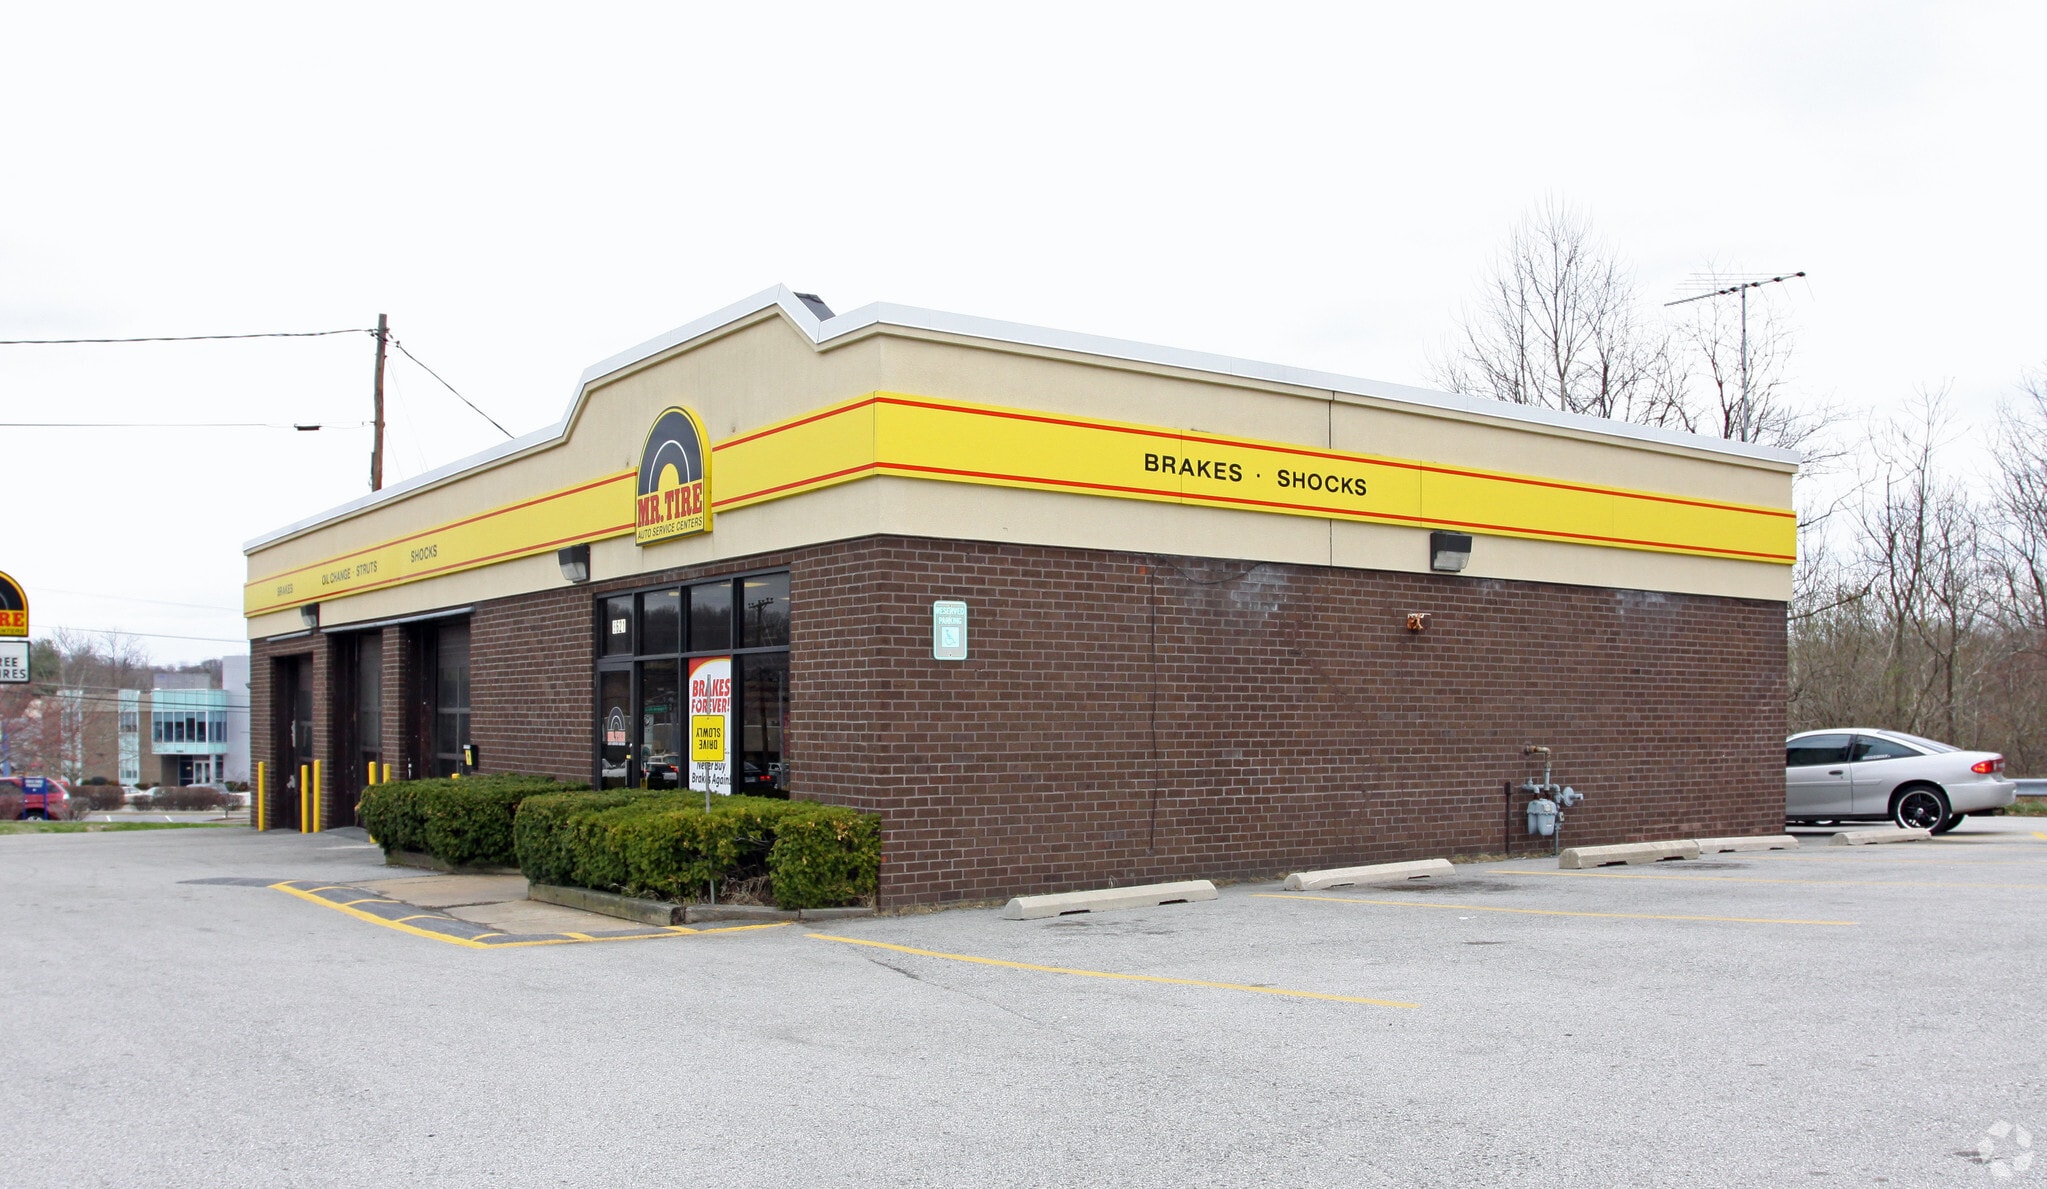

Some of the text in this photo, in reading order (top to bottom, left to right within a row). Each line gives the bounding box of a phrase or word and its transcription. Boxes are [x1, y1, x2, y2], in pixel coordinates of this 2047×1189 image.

[1144, 453, 1367, 496] BRAKES SHOCKS
[637, 482, 702, 528] MR. TIRE
[638, 516, 703, 540] AUTO SERVICE CENTERS
[410, 544, 438, 563] SHOCKS
[321, 560, 378, 586] OIL CHANGE STRUTS
[276, 583, 294, 597] BRAKES
[692, 678, 731, 697] BRAKES
[695, 727, 721, 738] SLOWLY
[698, 739, 718, 750] DRIVE
[696, 762, 727, 774] Neer Buy
[691, 772, 711, 784] Braks
